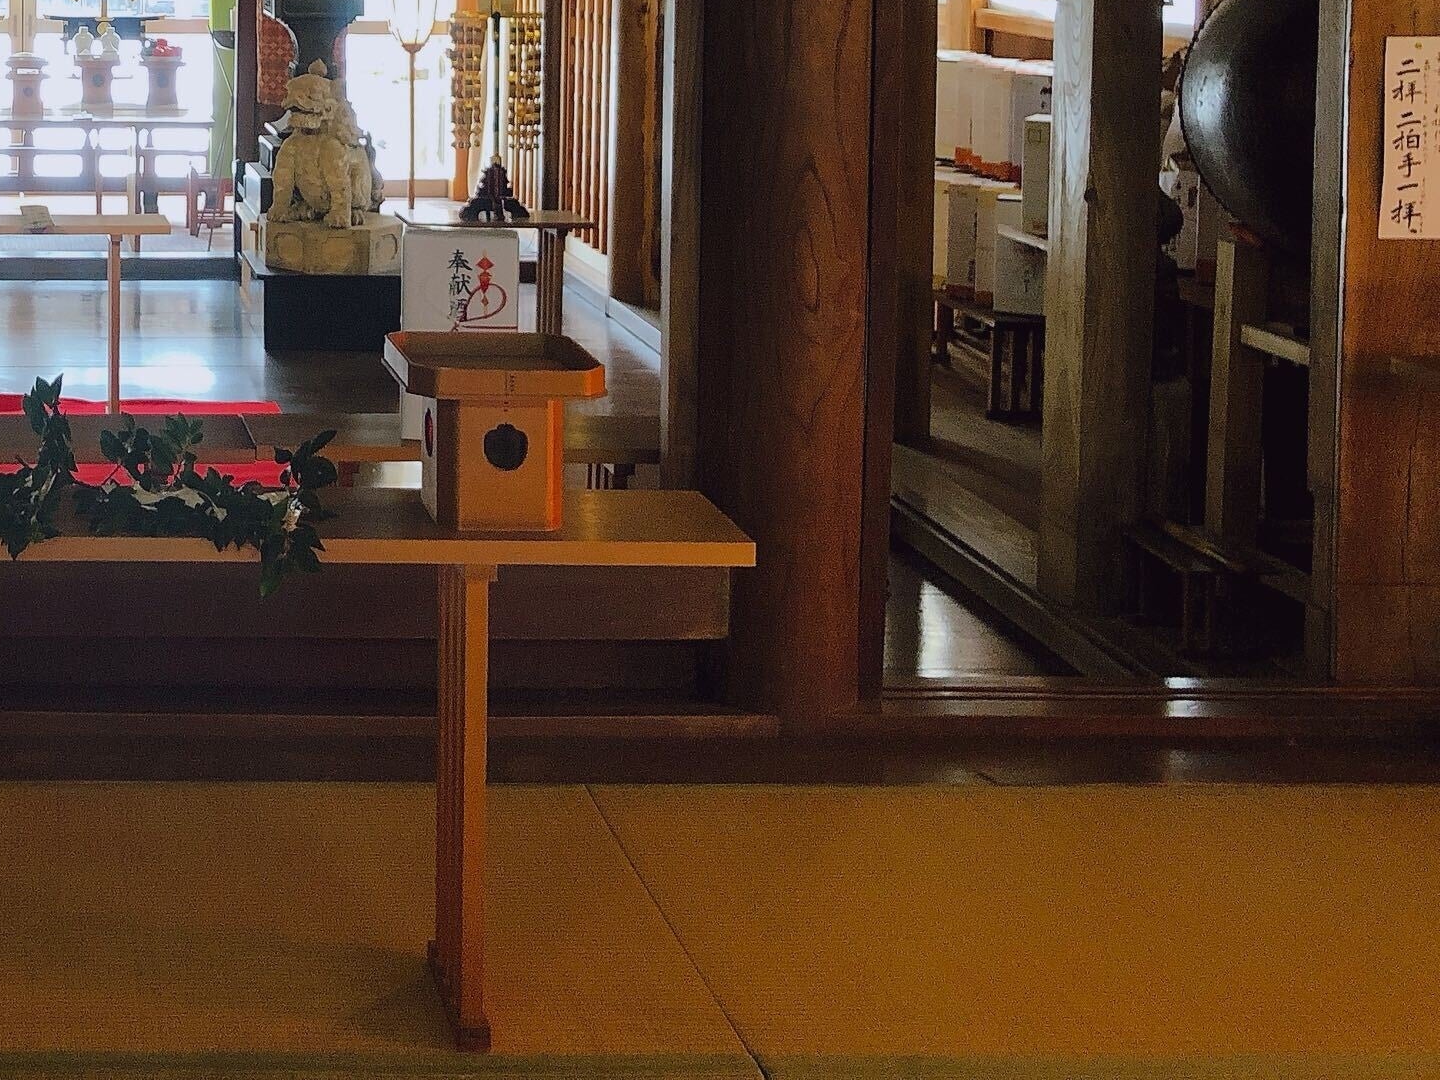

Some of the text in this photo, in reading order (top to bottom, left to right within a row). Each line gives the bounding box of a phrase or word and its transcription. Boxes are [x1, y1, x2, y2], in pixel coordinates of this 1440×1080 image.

[1391, 58, 1423, 229] 二拝二拍手一拝
